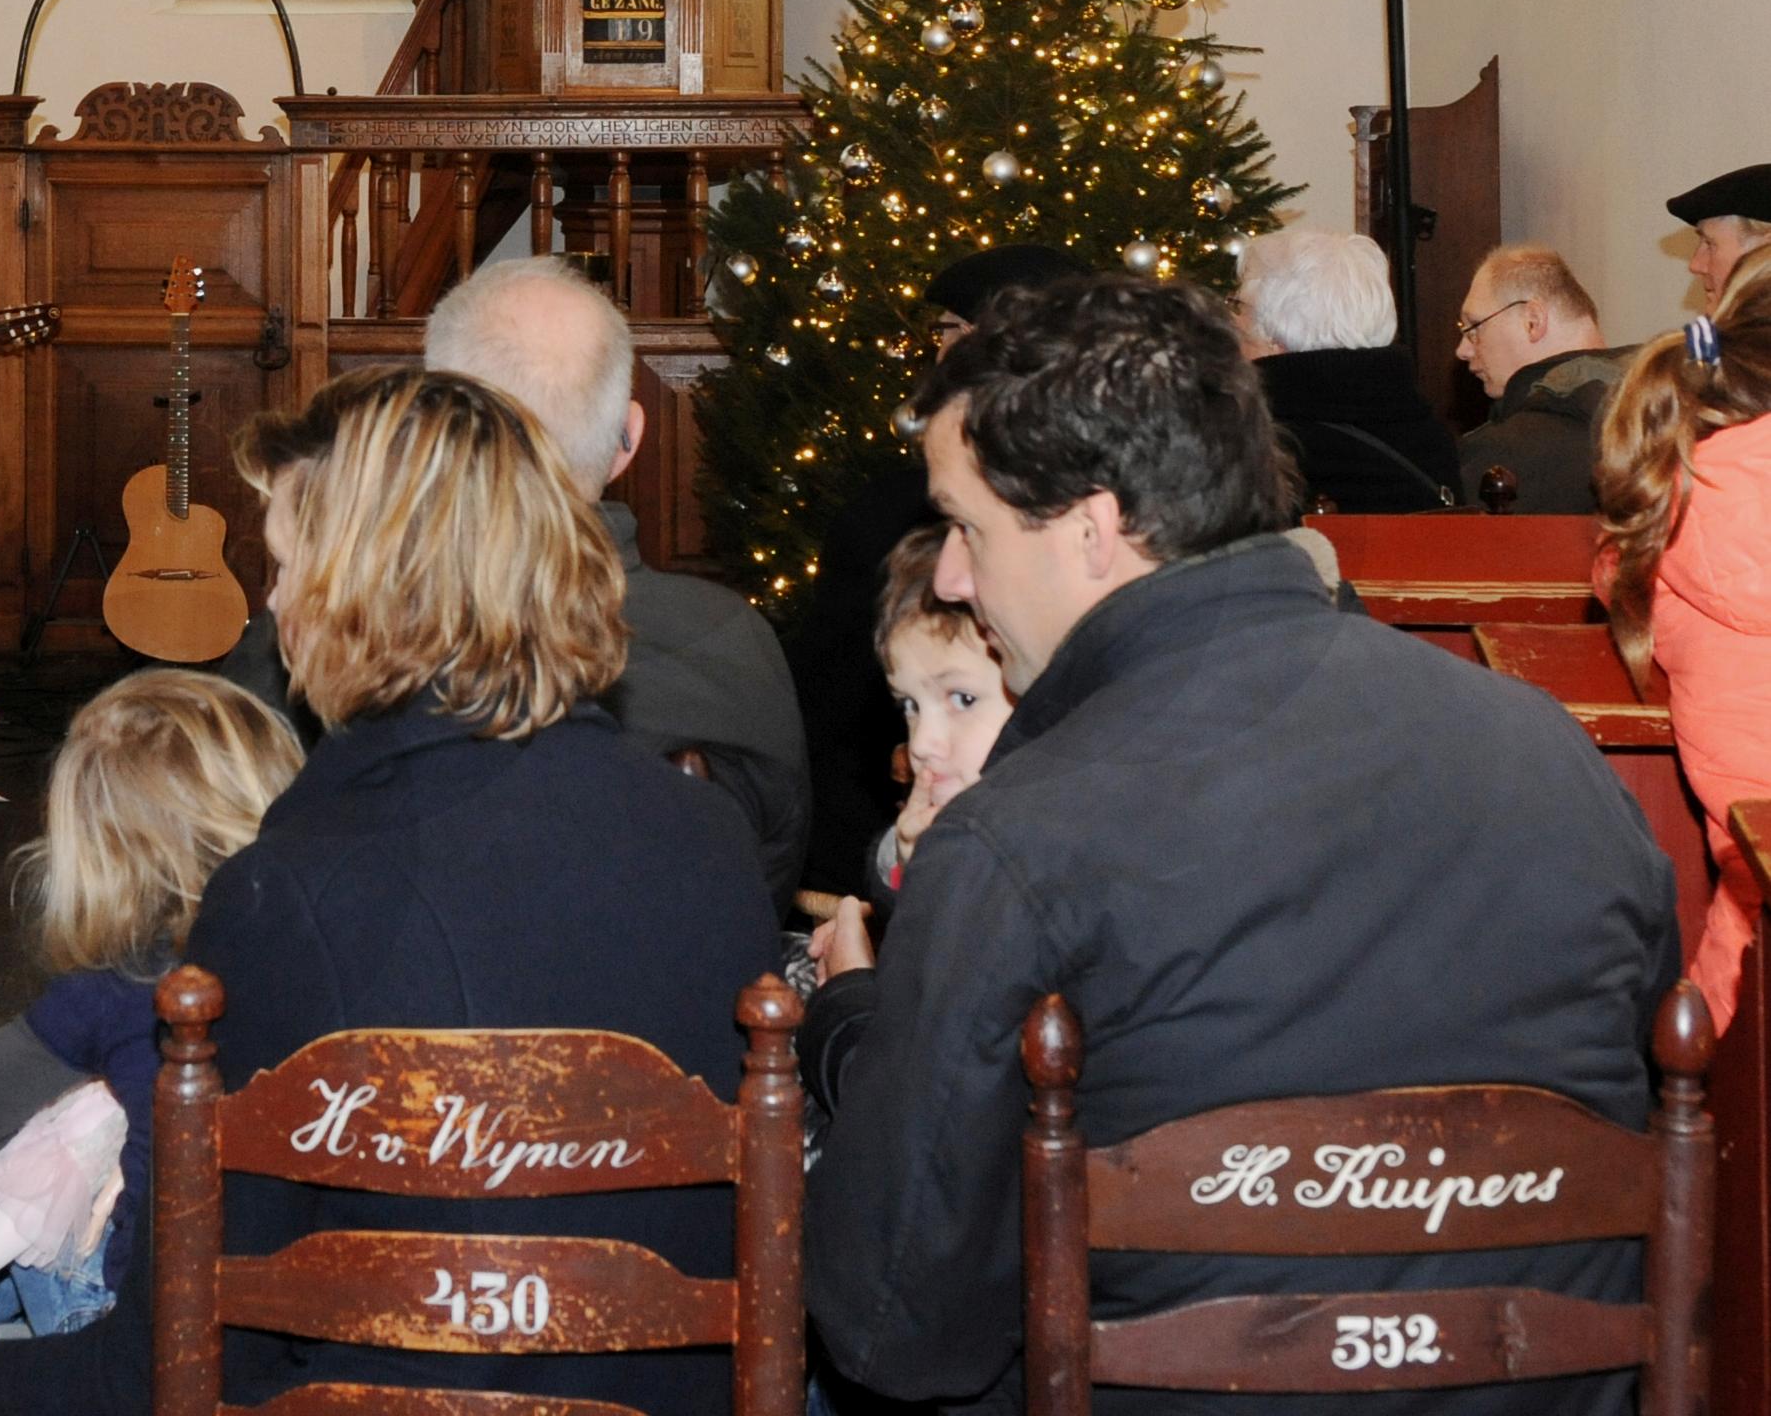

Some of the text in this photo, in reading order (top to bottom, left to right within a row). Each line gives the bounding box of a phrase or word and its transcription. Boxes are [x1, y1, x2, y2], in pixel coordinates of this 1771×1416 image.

[371, 134, 408, 146] DAT
[416, 134, 443, 146] ICK
[538, 133, 579, 146] MYN
[725, 132, 765, 144] KAN
[426, 120, 476, 133] LEERT
[485, 120, 523, 133] MYN
[529, 121, 577, 133] DOOR
[601, 120, 693, 133] HEYLIGHEN
[699, 119, 748, 132] GEEST
[1293, 1143, 1565, 1234] Kuipers
[422, 1269, 550, 1336] 430
[1331, 1314, 1441, 1370] 352
